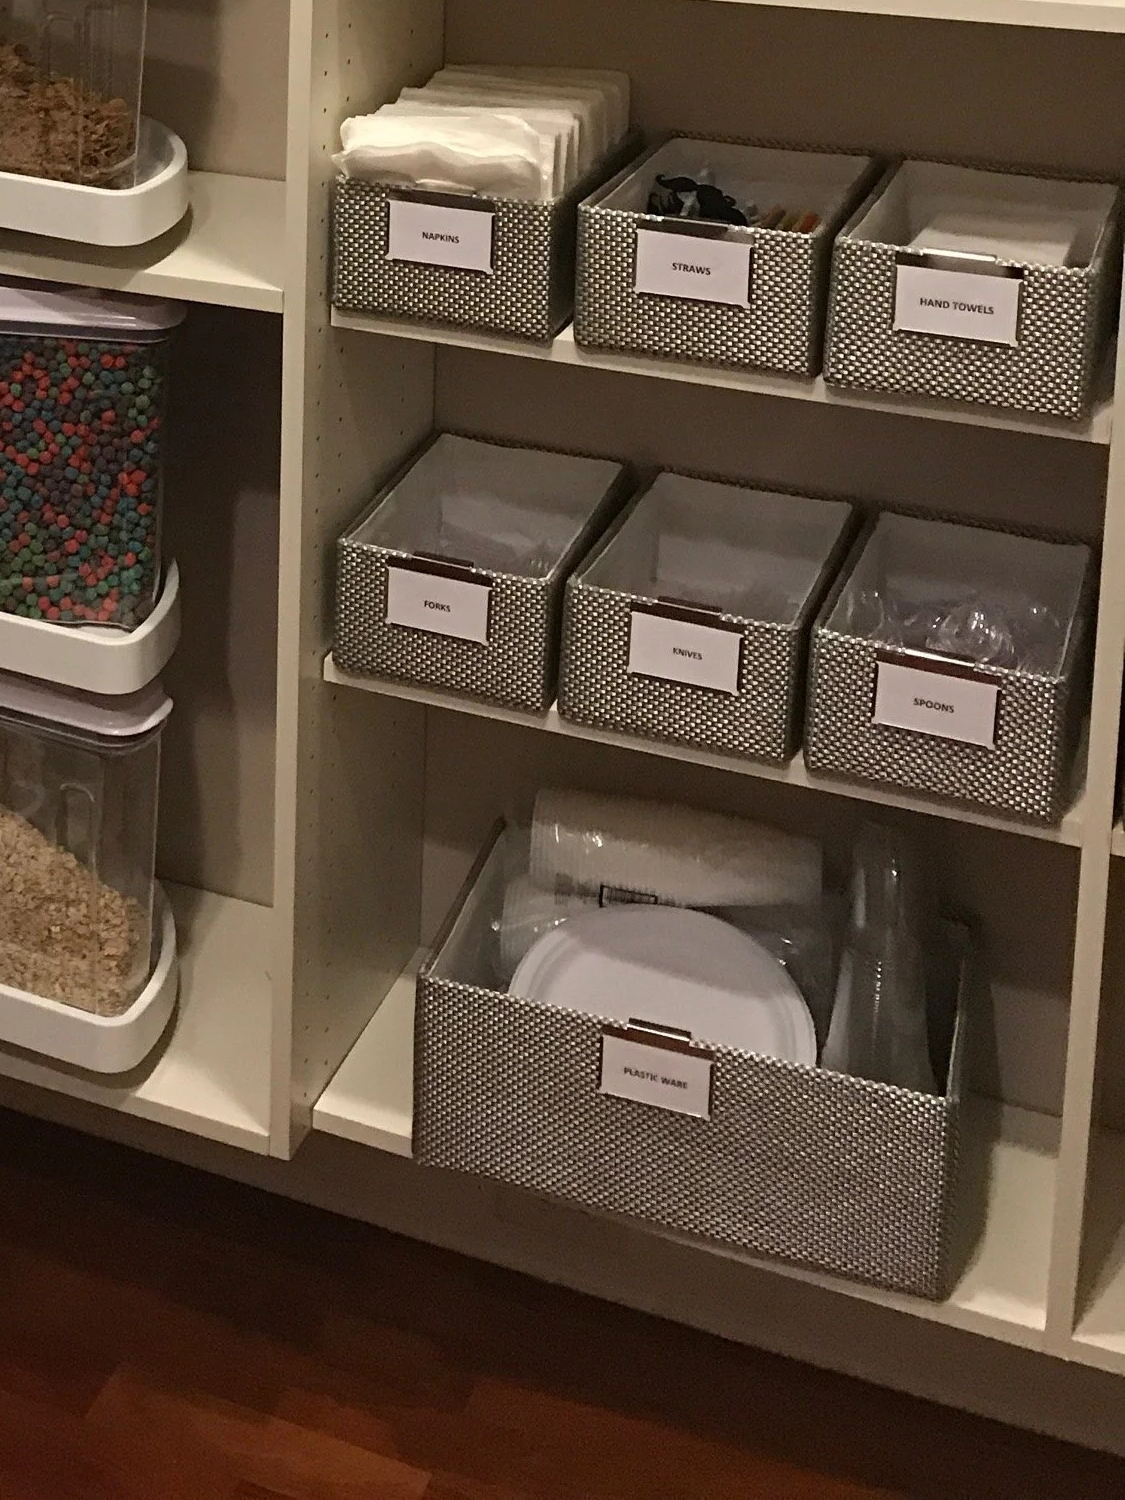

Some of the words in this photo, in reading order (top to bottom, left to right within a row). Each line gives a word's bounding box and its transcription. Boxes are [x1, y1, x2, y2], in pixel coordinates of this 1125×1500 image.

[422, 231, 460, 244] NAPKINS
[672, 262, 711, 276] STRAWS
[919, 297, 951, 309] HAND
[952, 301, 995, 316] TOWELS
[423, 599, 451, 613] FORKS
[672, 647, 703, 661] KNIVES
[913, 697, 955, 714] SPOONS
[623, 1066, 658, 1083] PLASTIC
[659, 1073, 689, 1090] WARE
